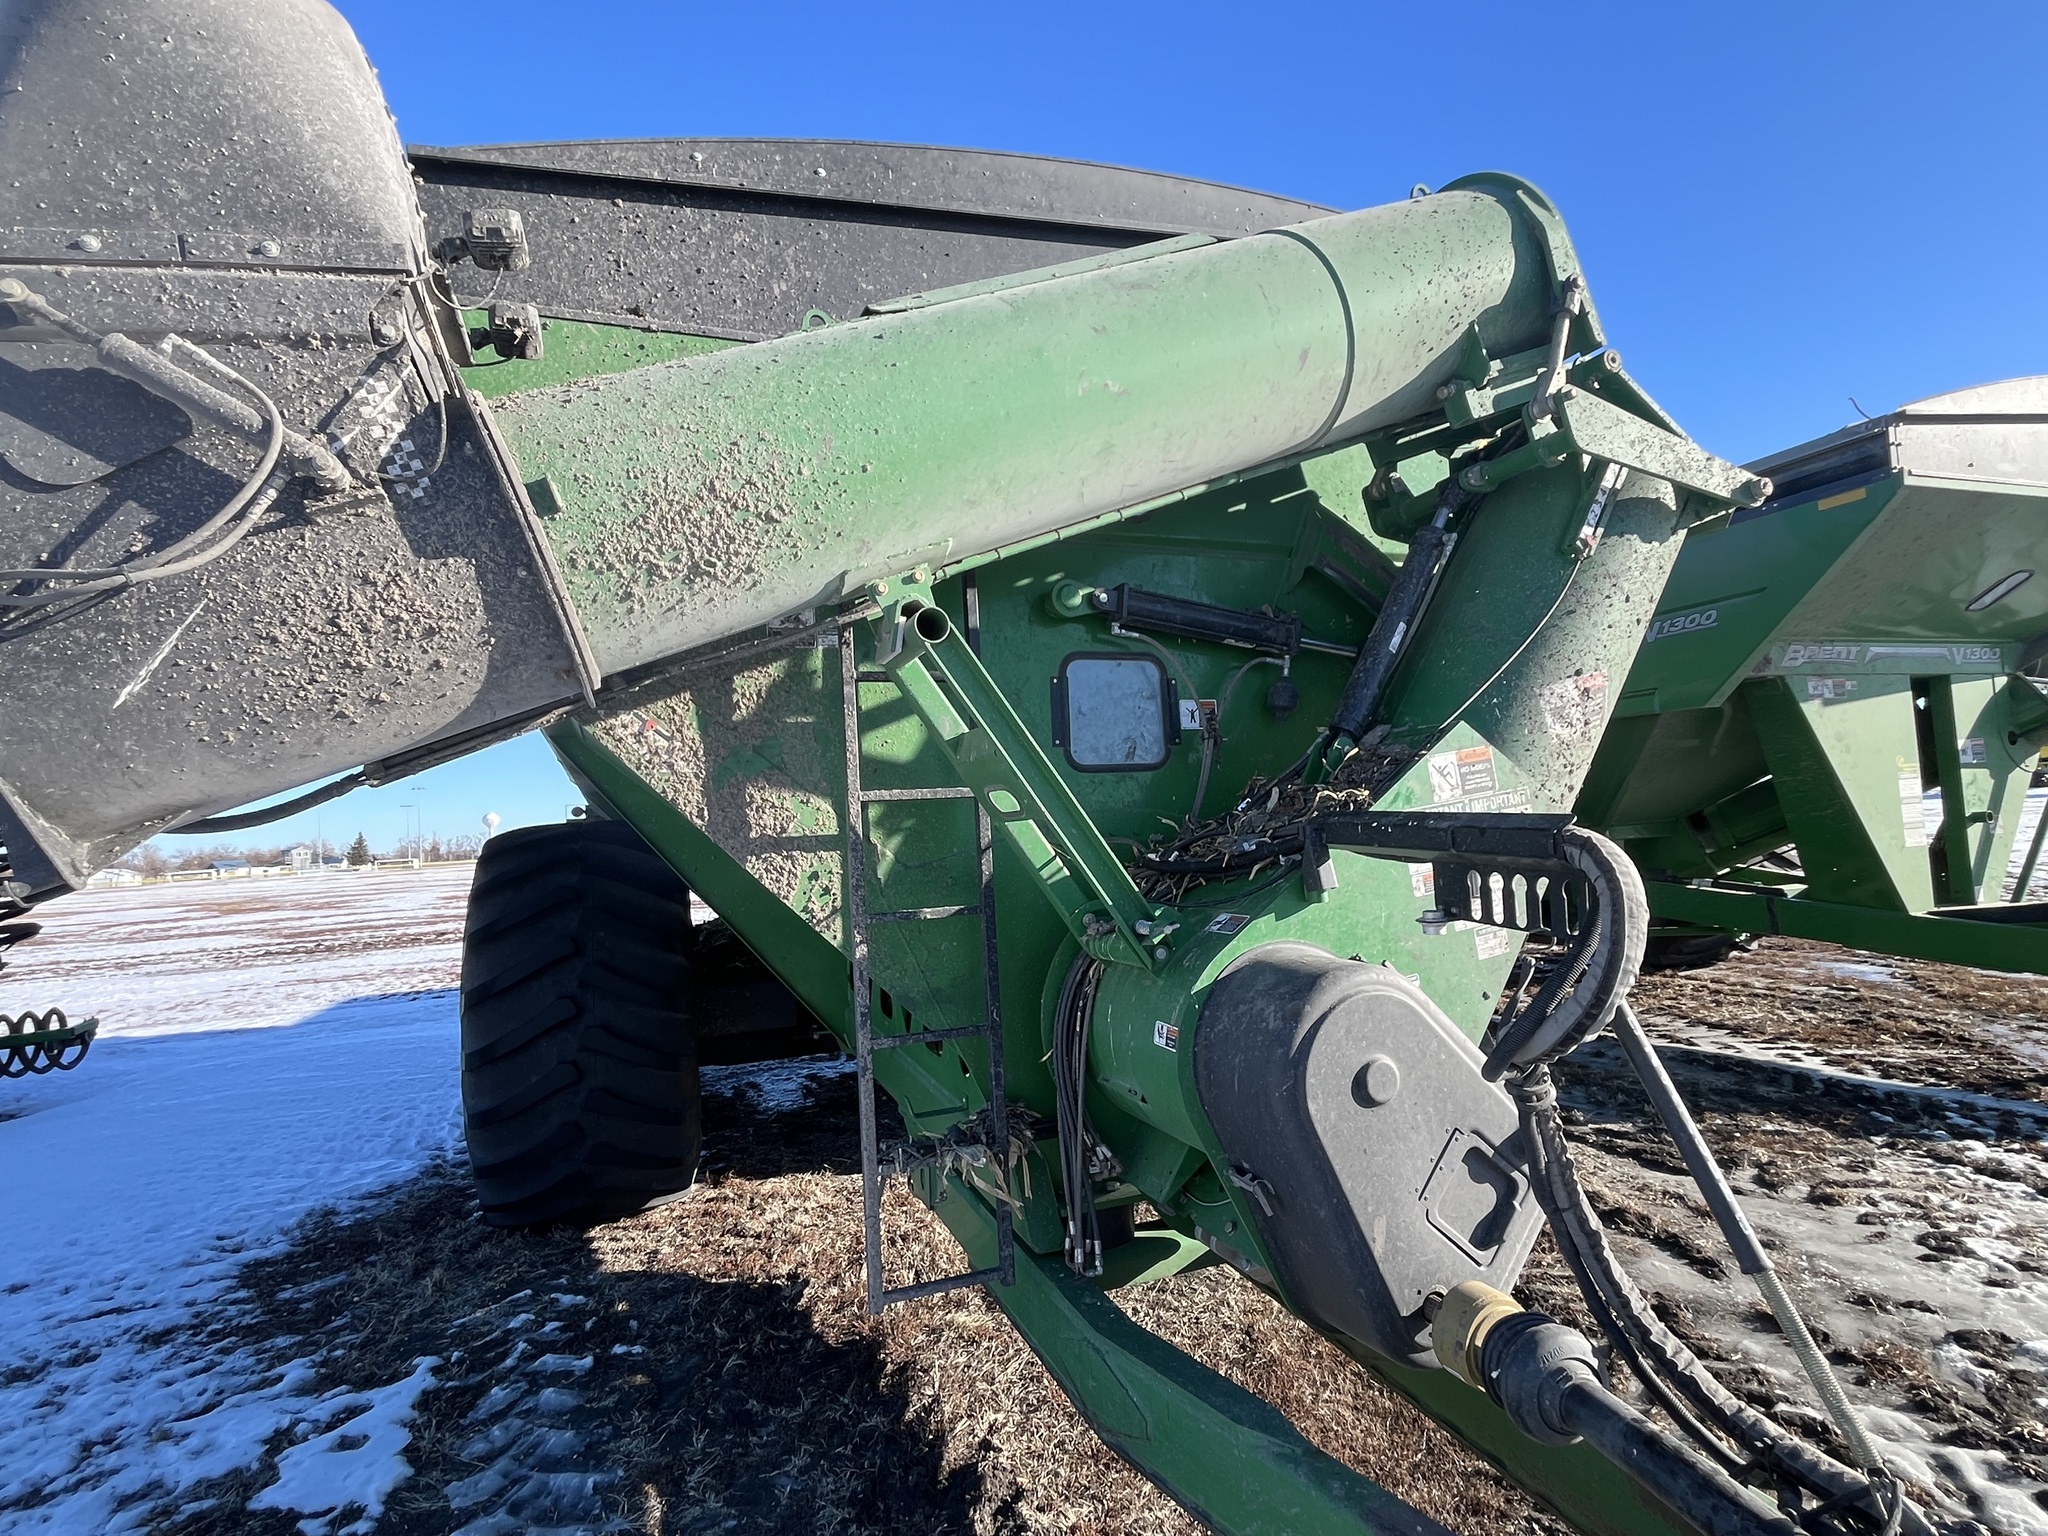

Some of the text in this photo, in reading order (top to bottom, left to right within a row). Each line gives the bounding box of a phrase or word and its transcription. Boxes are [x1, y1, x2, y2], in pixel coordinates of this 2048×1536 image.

[1646, 610, 1717, 642] V1300
[1781, 645, 2001, 667] BRENT V1300
[1471, 790, 1526, 812] IMPORTANT
